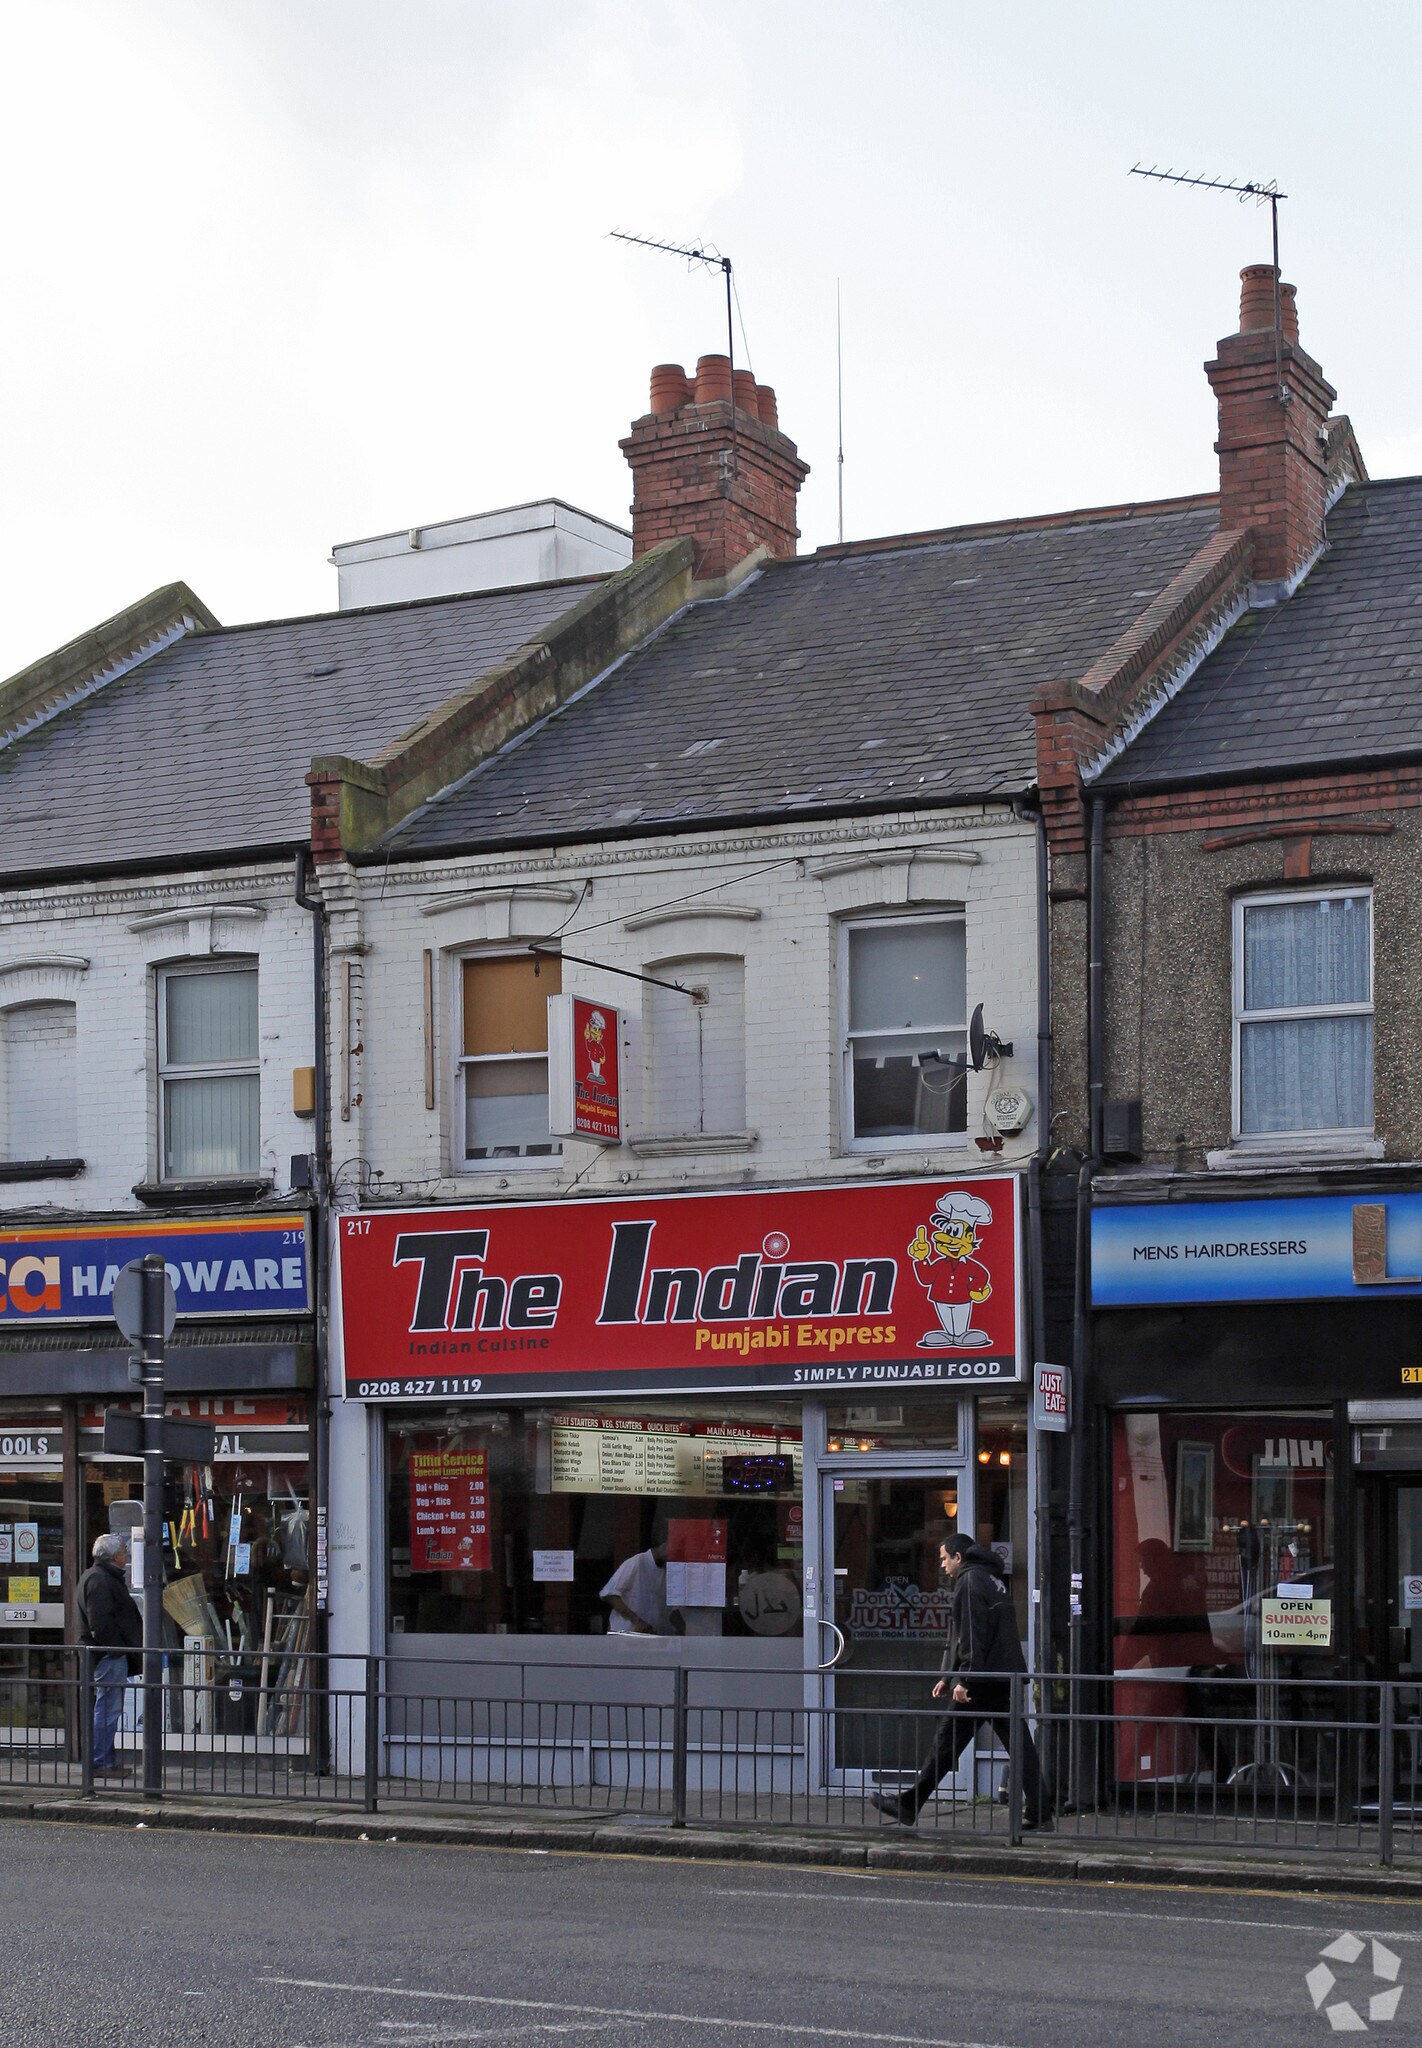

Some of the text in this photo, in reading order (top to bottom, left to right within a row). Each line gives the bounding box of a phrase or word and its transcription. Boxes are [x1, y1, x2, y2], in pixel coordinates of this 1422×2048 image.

[576, 1082, 618, 1107] The Indian
[576, 1101, 618, 1118] Punjabi Express
[576, 1117, 618, 1135] 0208 427 1119
[347, 1220, 371, 1235] 217
[282, 1232, 306, 1245] 219
[1133, 1240, 1307, 1260] MENS HAIRDRESSERS
[72, 1257, 303, 1297] HADWARE
[393, 1220, 898, 1332] The Indian
[409, 1338, 550, 1355] Indian Cuisine
[695, 1324, 896, 1355] Punjabi Express
[794, 1362, 1001, 1381] SIMPLY PUNJABI FOOD
[358, 1379, 482, 1396] 0208 427 1119
[1040, 1373, 1062, 1392] JUST
[1045, 1394, 1061, 1411] EAT
[286, 1404, 308, 1424] 21
[554, 1416, 599, 1428] MEAT STARTERS
[601, 1419, 643, 1430] VEG. STARTERS
[647, 1422, 680, 1433] QUICK BITES
[706, 1427, 726, 1436] MAIN
[726, 1428, 751, 1438] MEALS
[0, 1437, 48, 1456] OOLS
[413, 1453, 485, 1467] Tiffin Service
[414, 1466, 484, 1477] Special Lunch Offer
[415, 1483, 427, 1492] Dal
[433, 1483, 449, 1491] Rice
[469, 1481, 485, 1490] 2.00
[416, 1498, 430, 1507] Veg
[435, 1497, 452, 1506] Rice
[470, 1496, 485, 1505] 2.50
[416, 1511, 444, 1521] Chicken
[450, 1511, 466, 1520] Rice
[470, 1510, 485, 1519] 3.00
[416, 1526, 435, 1535] Lamb
[441, 1526, 456, 1534] Rice
[470, 1525, 486, 1534] 3.50
[885, 1576, 909, 1584] OPEN
[855, 1589, 950, 1605] Don't cook
[1280, 1602, 1313, 1611] OPEN
[14, 1611, 27, 1619] 219
[851, 1607, 951, 1628] JUST EAT
[1265, 1615, 1328, 1625] SUNDAYS
[853, 1631, 879, 1639] ORDER
[1266, 1630, 1295, 1639] 10am
[1306, 1630, 1328, 1640] 4pm
